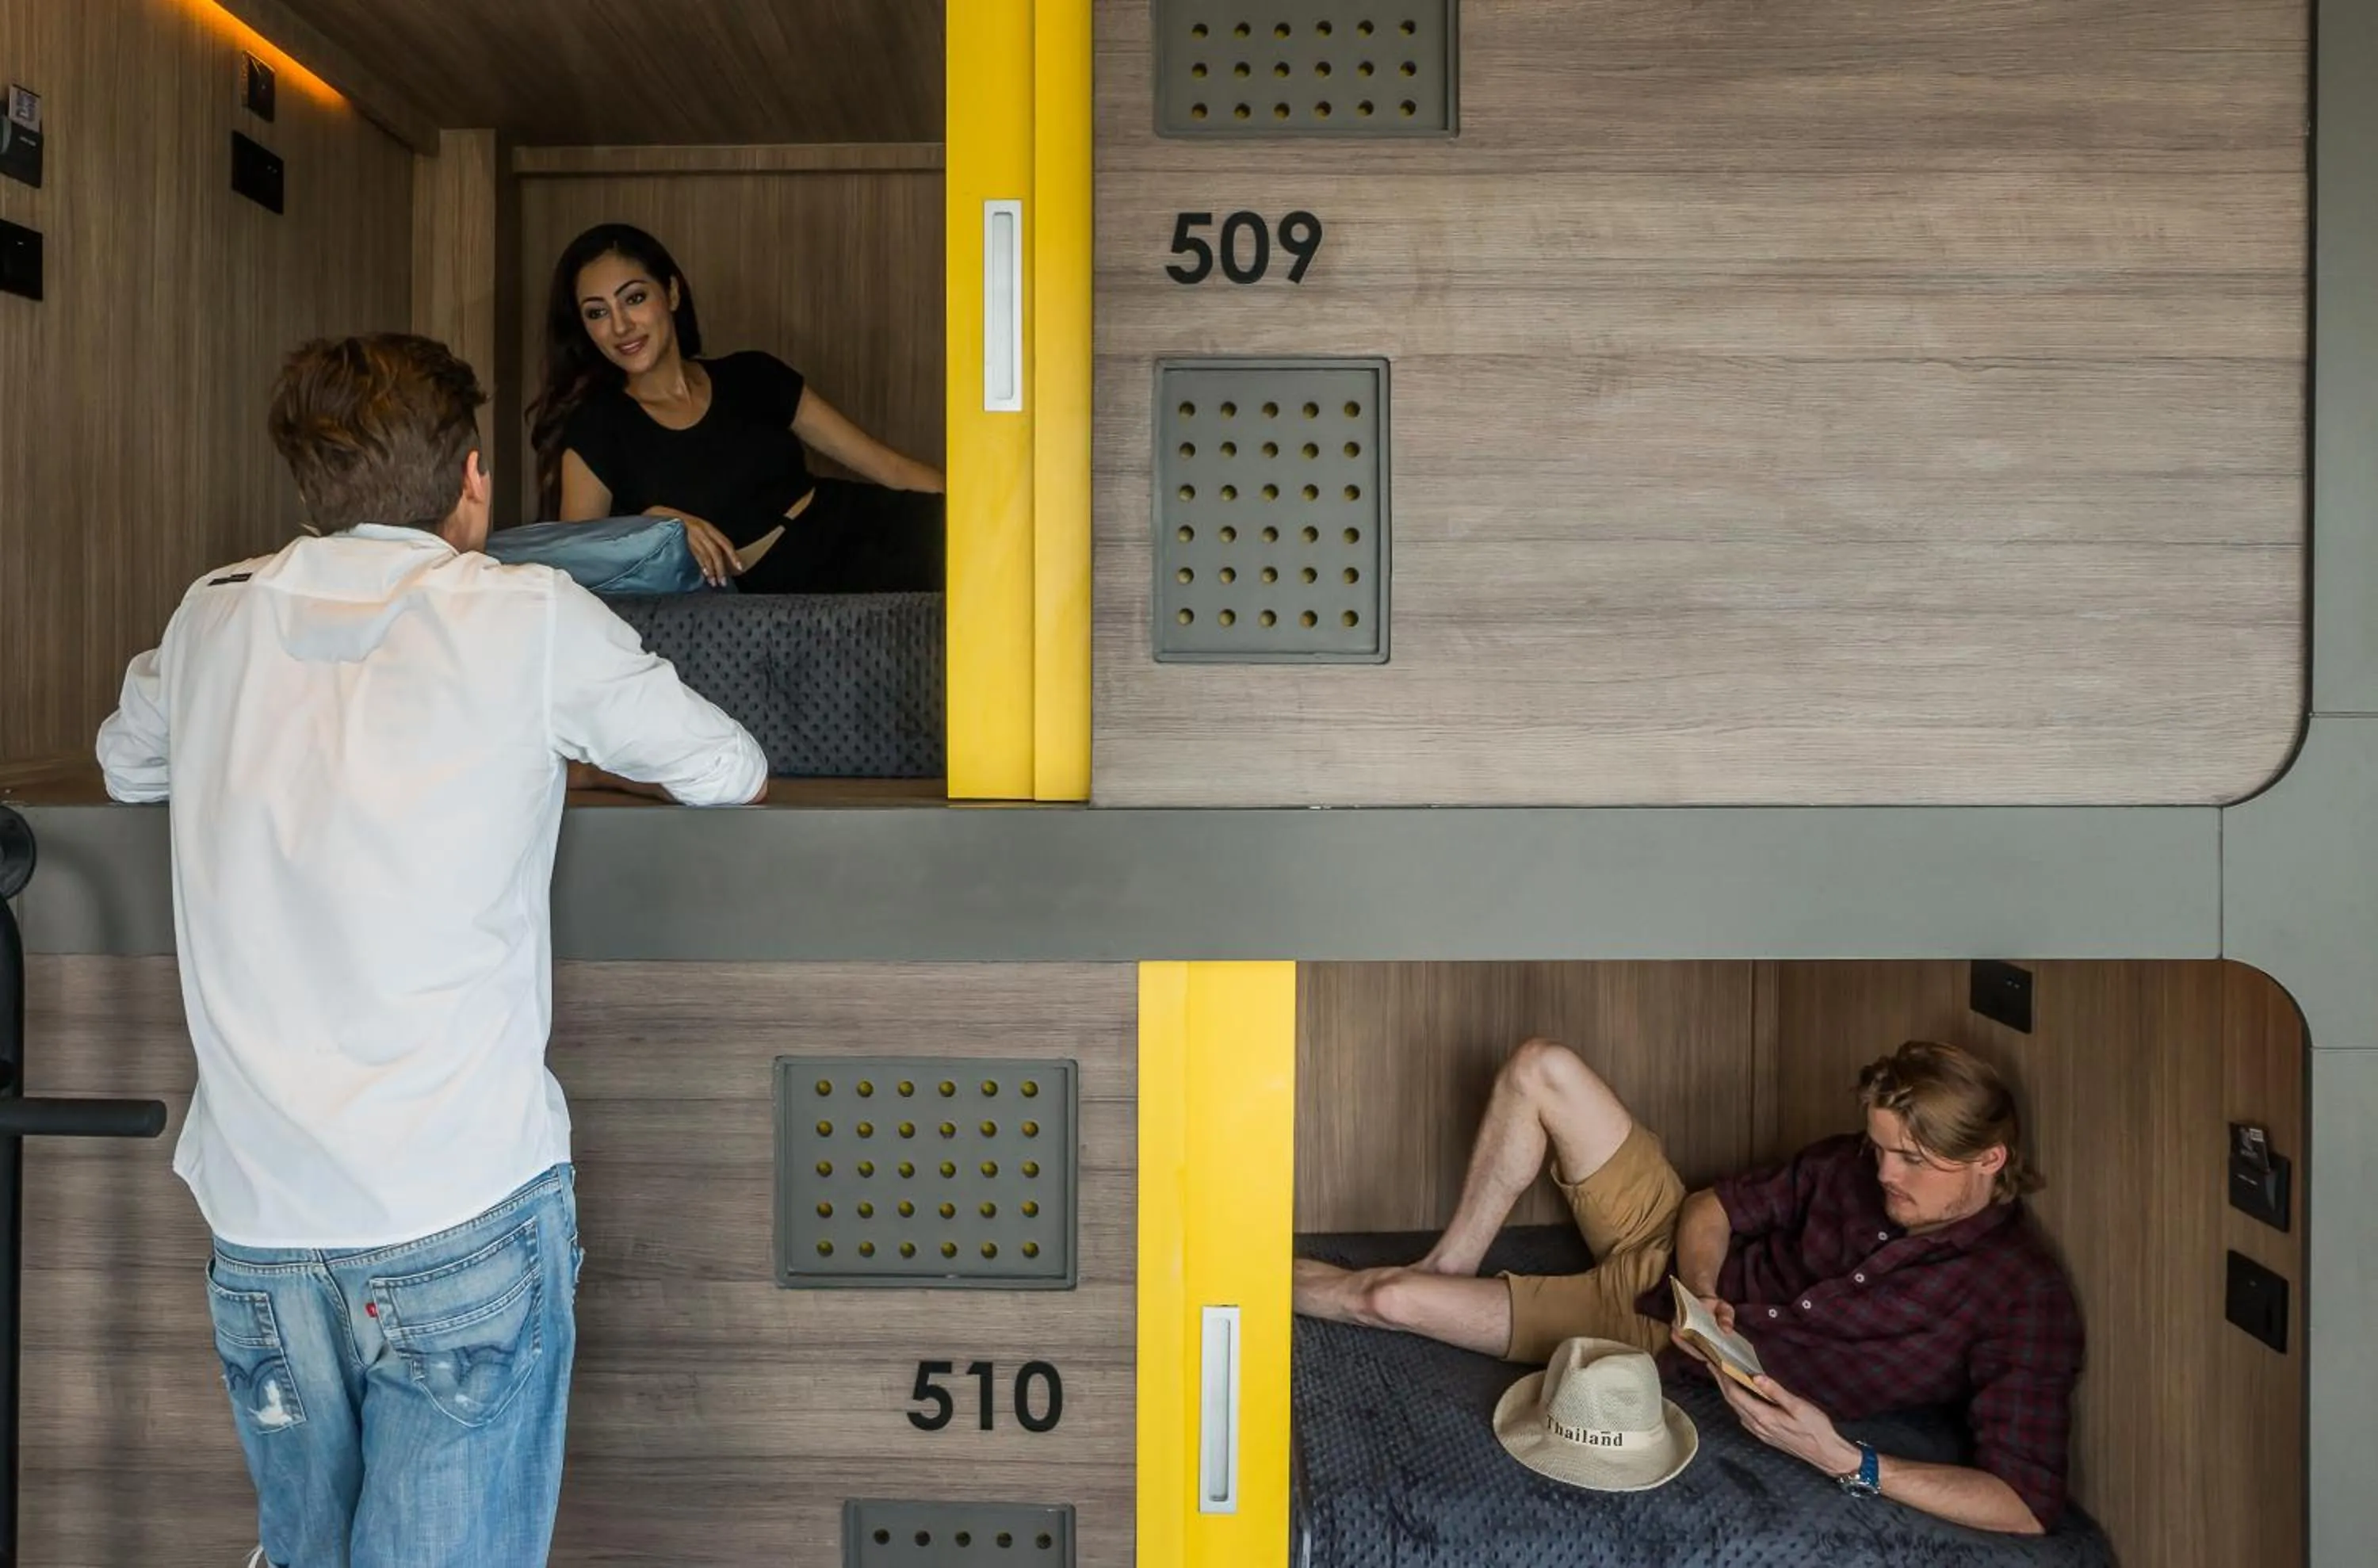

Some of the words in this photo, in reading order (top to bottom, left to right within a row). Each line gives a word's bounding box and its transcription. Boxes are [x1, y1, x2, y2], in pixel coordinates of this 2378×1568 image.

[1166, 211, 1322, 285] 509
[908, 1360, 1063, 1432] 510
[1546, 1415, 1623, 1447] Thailand
